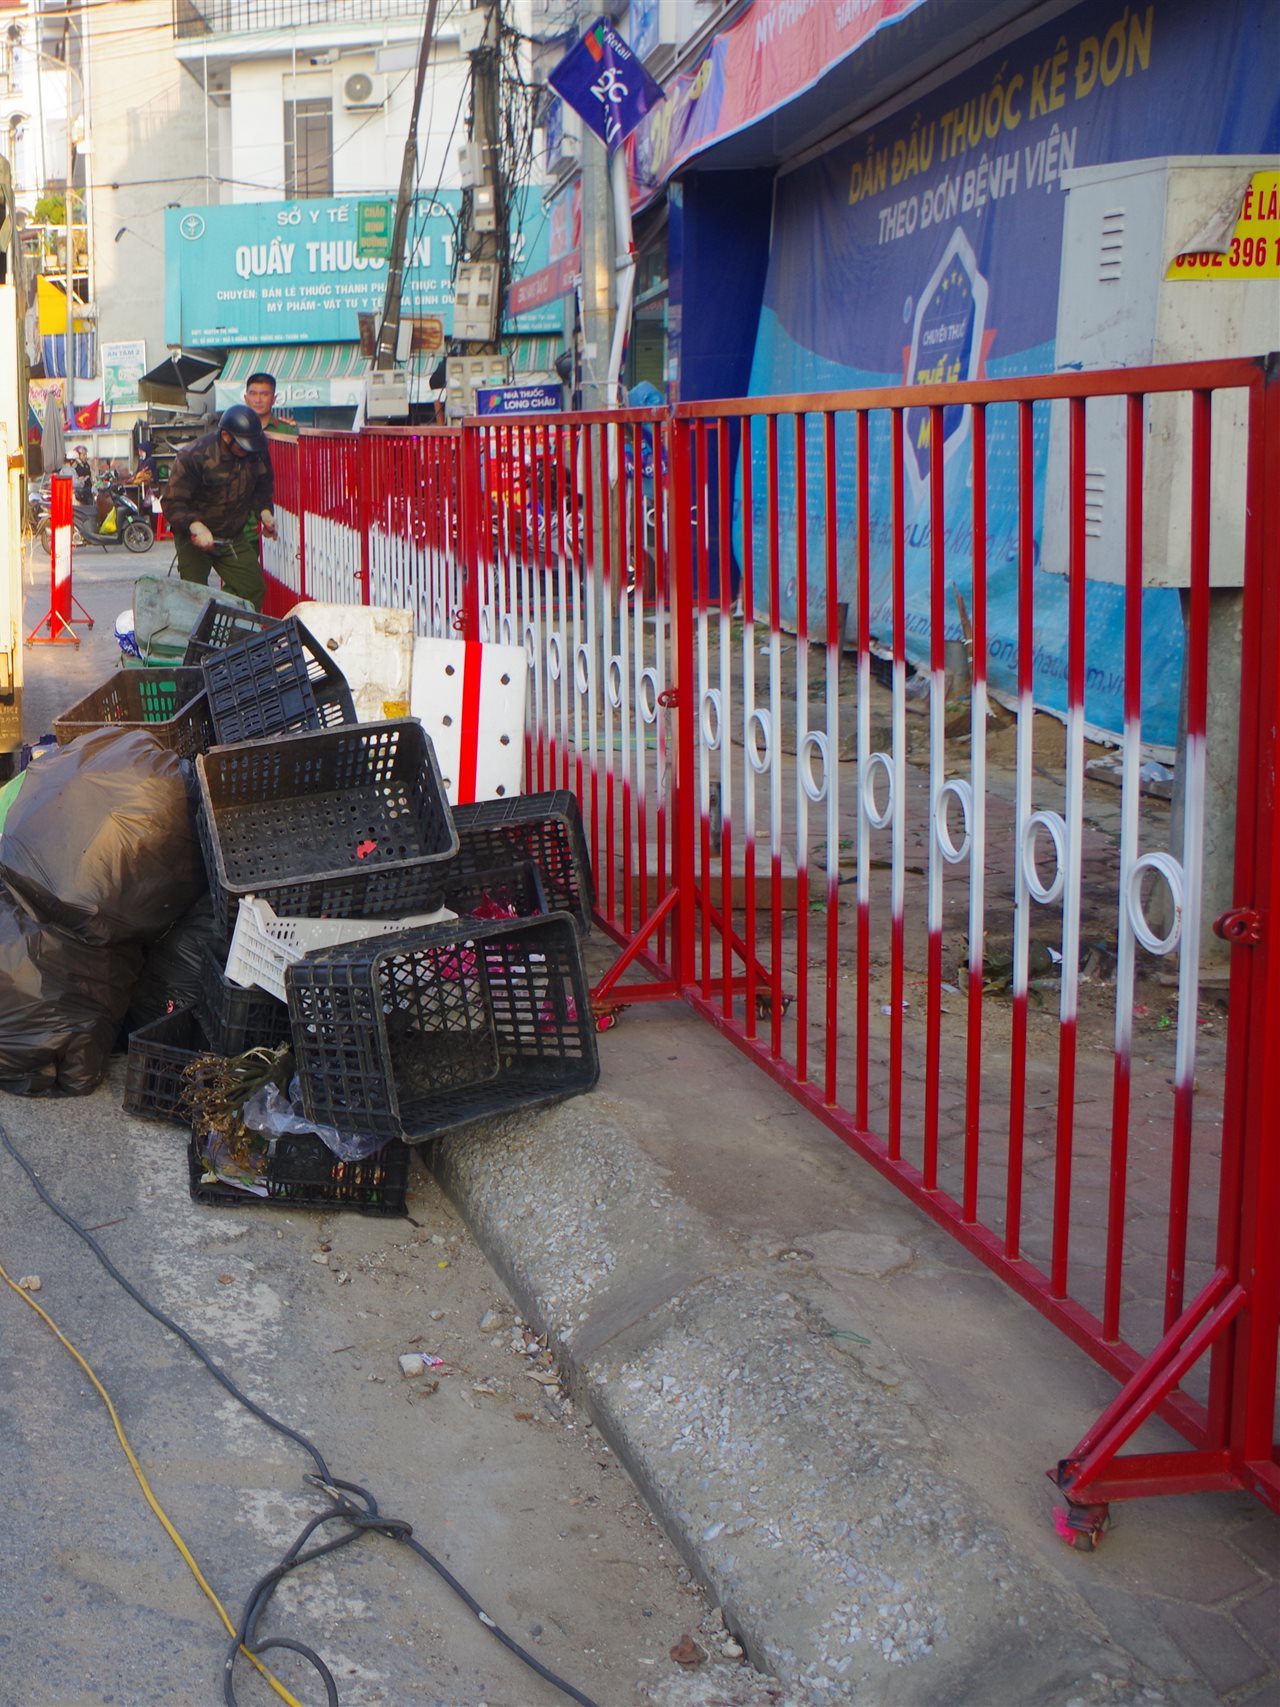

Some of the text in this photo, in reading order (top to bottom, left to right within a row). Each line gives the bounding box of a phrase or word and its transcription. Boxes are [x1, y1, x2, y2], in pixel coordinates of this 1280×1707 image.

[605, 32, 632, 61] Retail
[890, 112, 935, 186] ĐẦU
[940, 59, 1025, 162] THUỐC
[1029, 35, 1069, 120] KÊ
[1074, 5, 1154, 100] ĐƠN
[878, 123, 1078, 245] THEO ĐƠN BỆNH VIỆN
[277, 206, 302, 225] SỞ
[309, 210, 320, 224] Y
[326, 203, 349, 223] TẾ
[235, 236, 296, 280] QUẦY
[1229, 237, 1267, 267] 396
[300, 282, 332, 296] THUỐC
[504, 399, 530, 410] LONG
